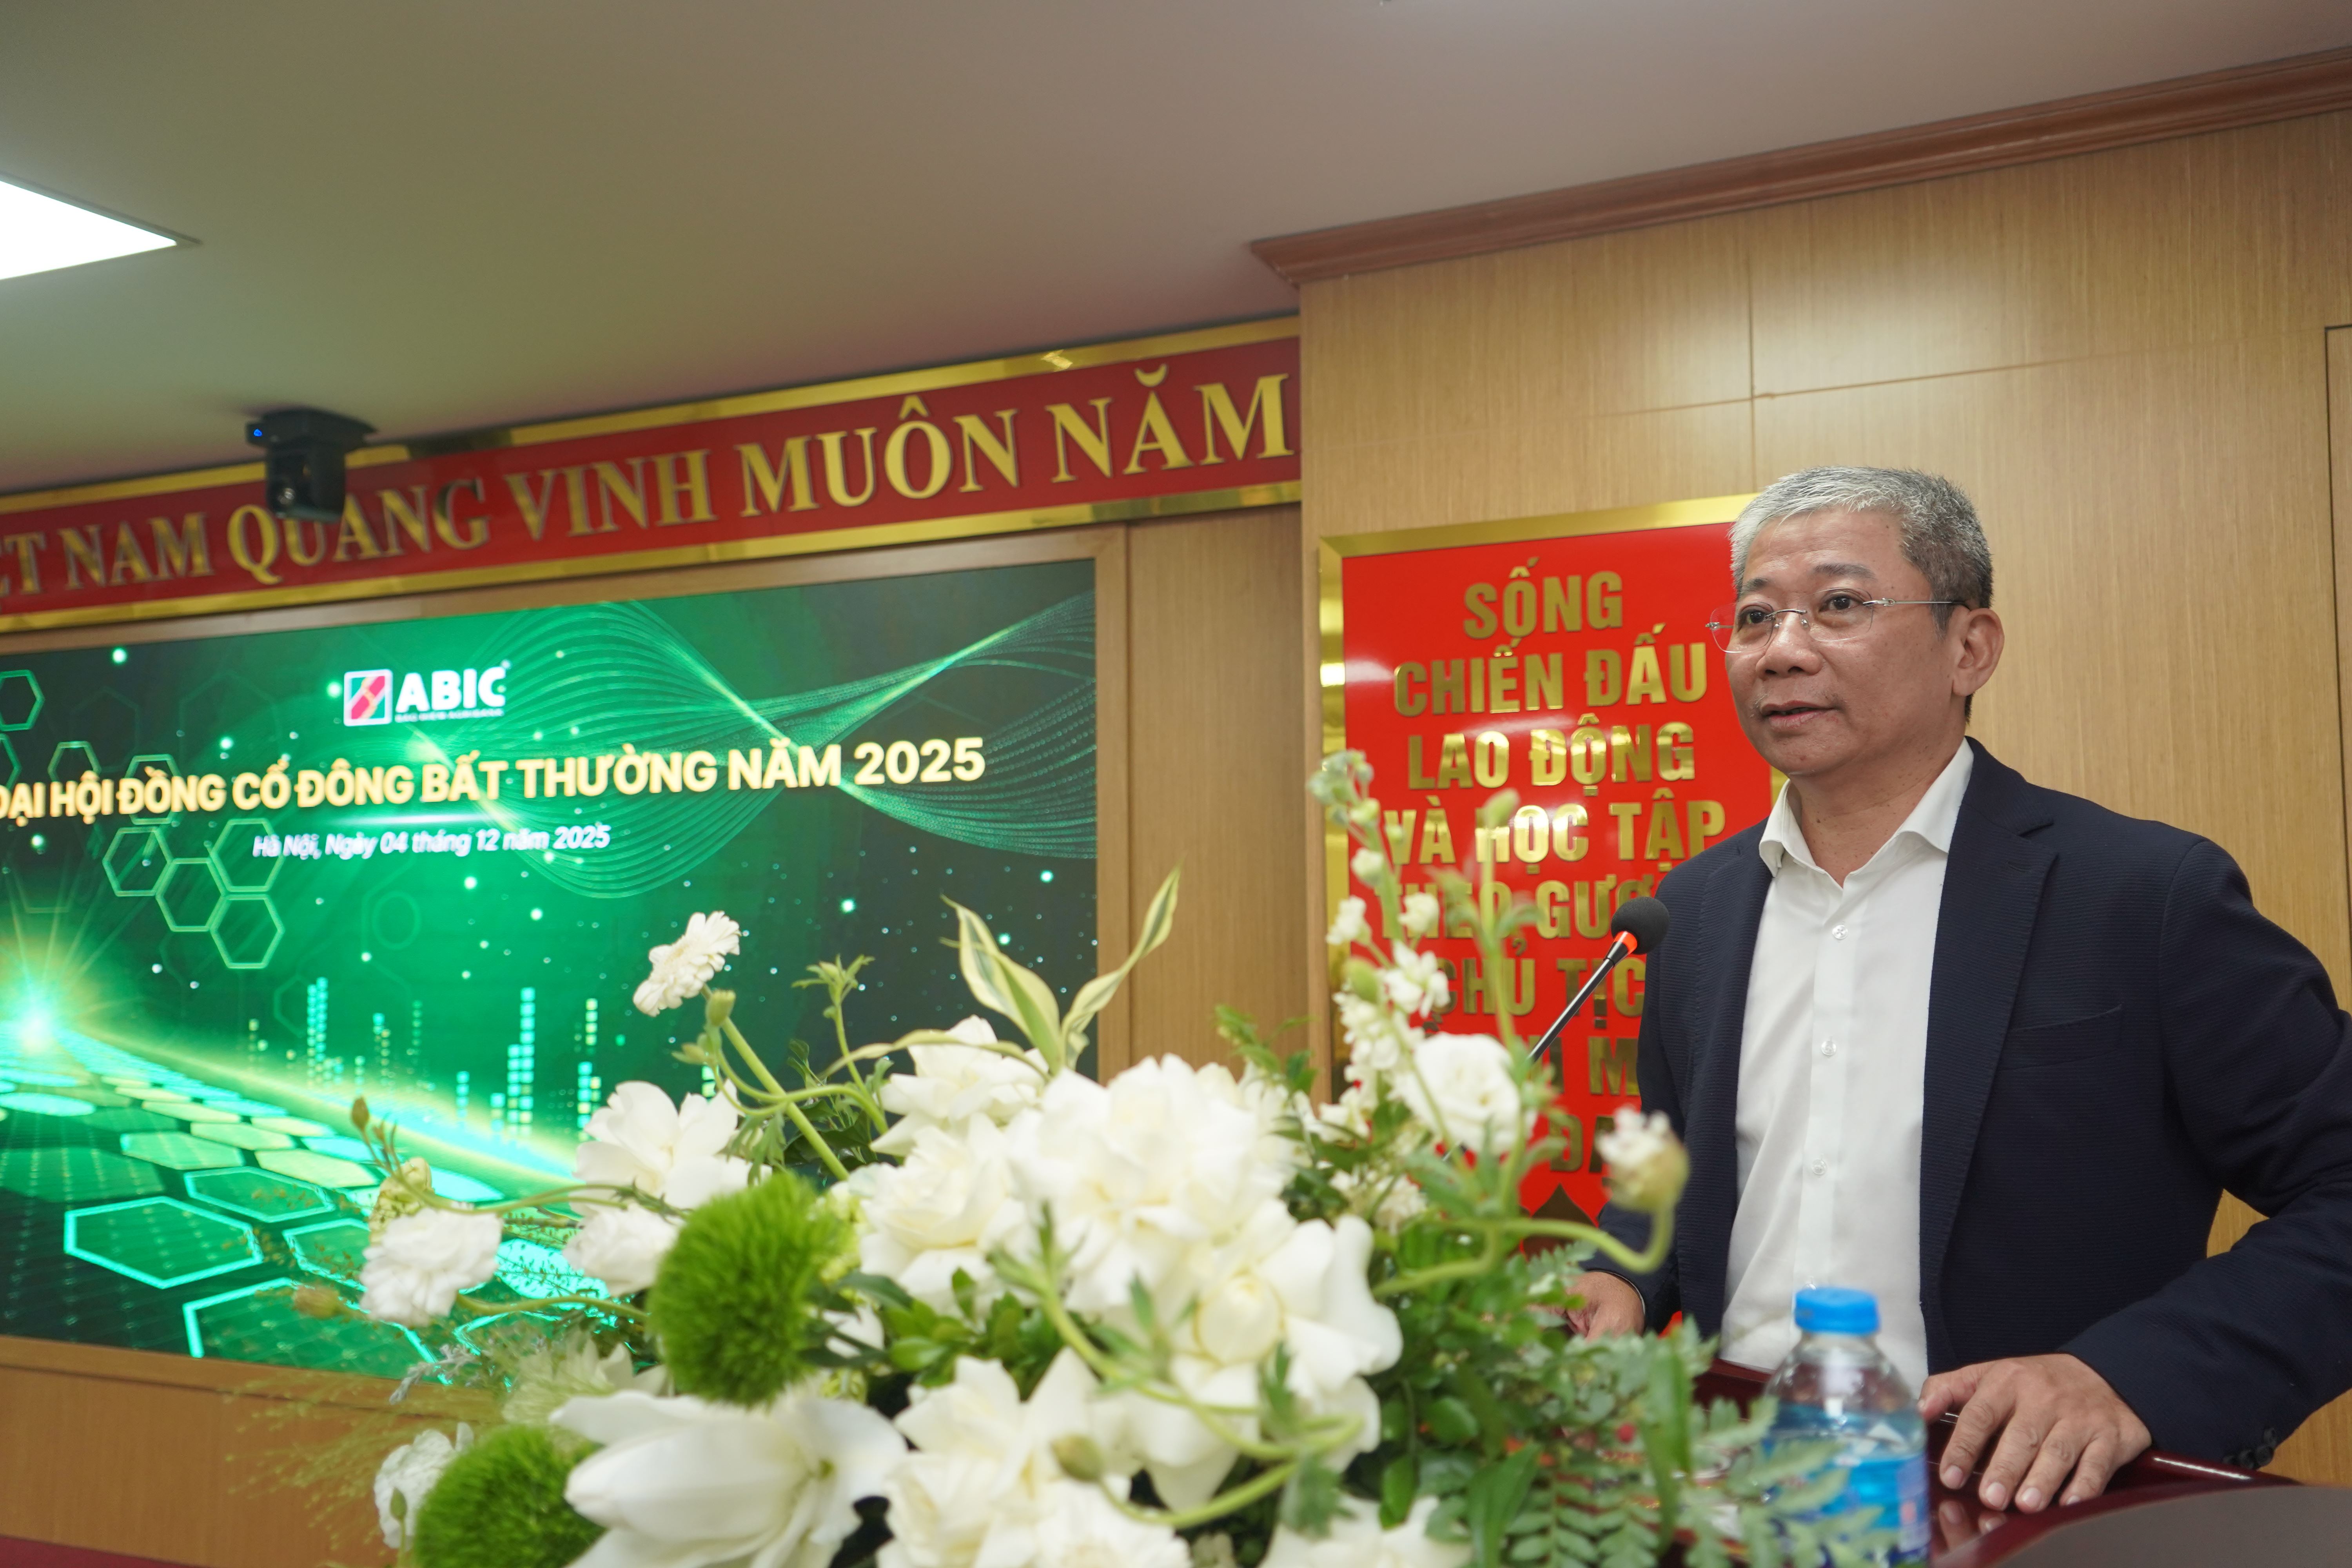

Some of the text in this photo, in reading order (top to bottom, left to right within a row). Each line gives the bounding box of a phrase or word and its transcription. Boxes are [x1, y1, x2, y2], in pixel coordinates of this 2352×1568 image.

[0, 363, 1295, 596] T NAM QUANG VINH MUÔN NĂM
[1463, 557, 1623, 639] SỐNG
[395, 667, 506, 713] ABIC
[1394, 623, 1707, 717] CHIẾN ĐẤU
[50, 770, 114, 824] HỘI
[116, 766, 227, 814] ĐỒNG
[294, 758, 414, 807] ĐÔNG
[421, 750, 509, 802] BẤT
[515, 743, 717, 799] THƯỜNG
[728, 737, 841, 790] NĂM
[854, 737, 985, 786] 2025
[1408, 713, 1696, 796] LAO ĐỘNG
[252, 824, 612, 860] Hà Nội, Ngày 04 tháng 12 năm 2025
[1383, 787, 1726, 875] VÀ HỌC TẬP
[1556, 957, 1646, 1029] TỊC
